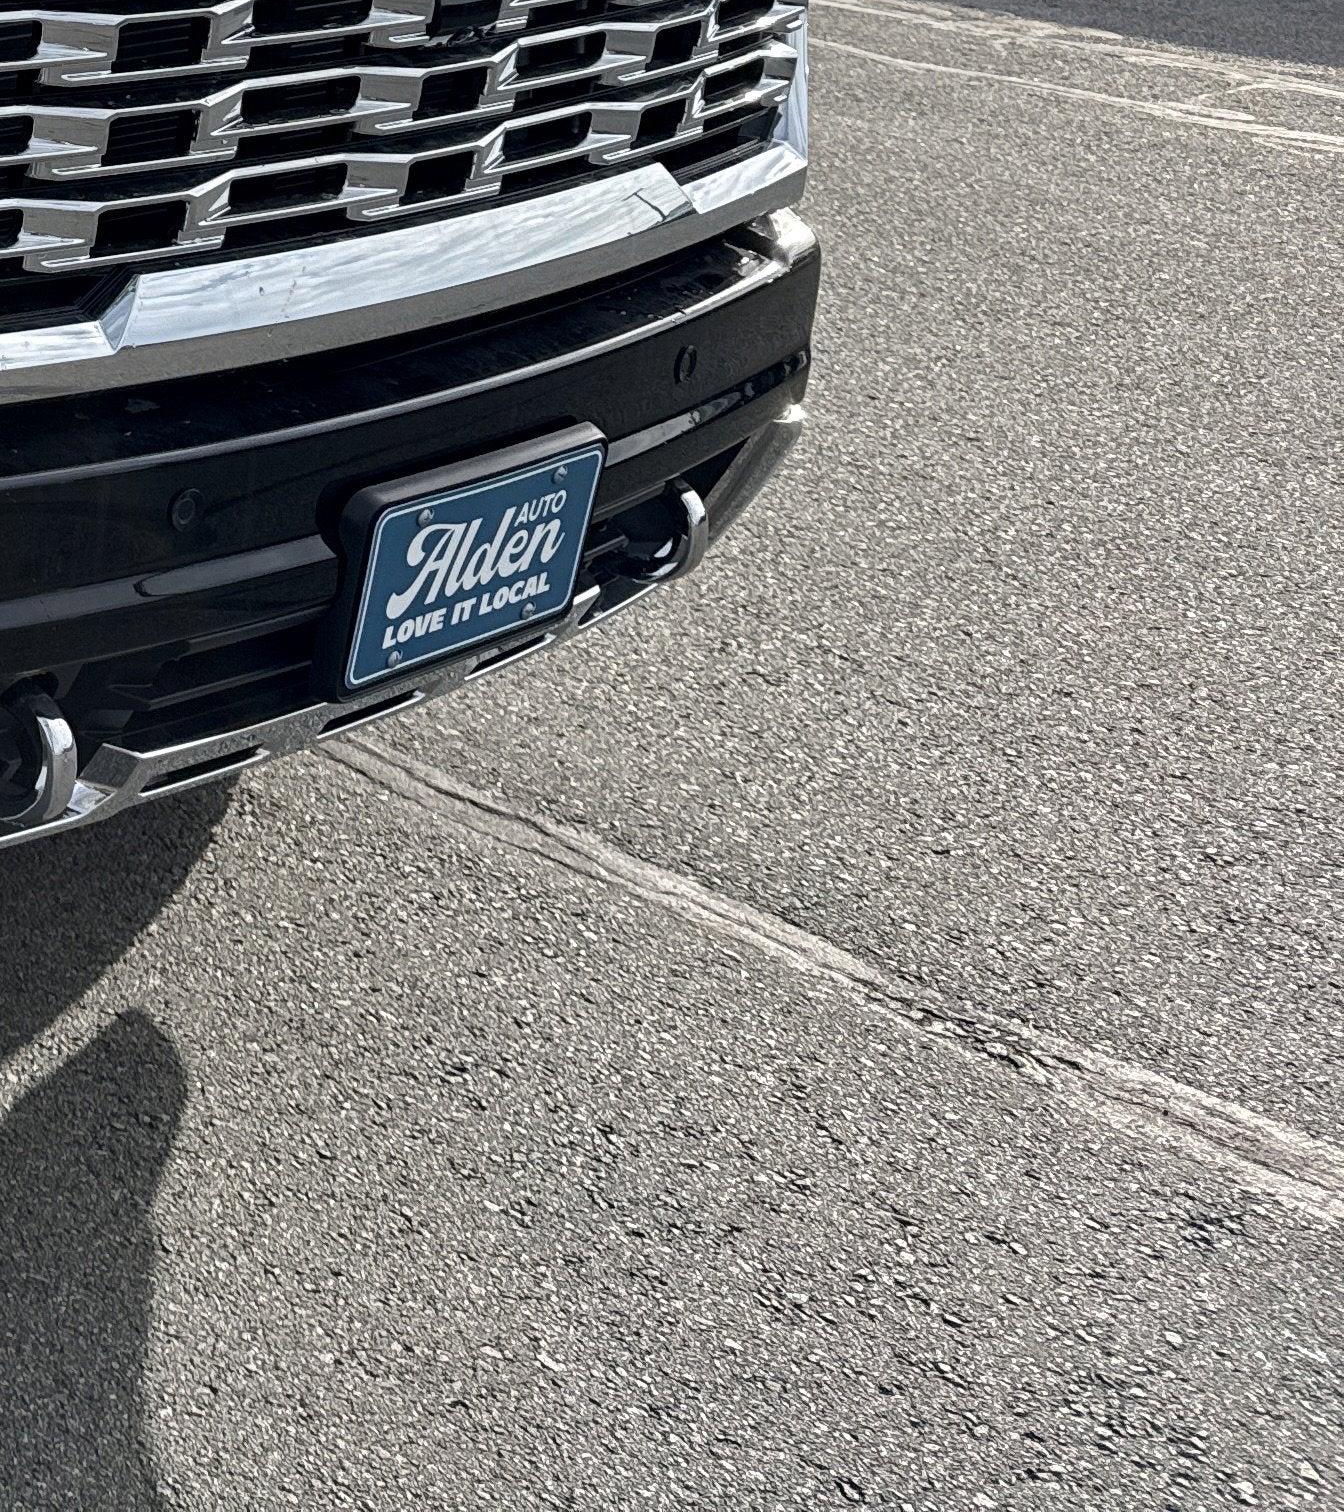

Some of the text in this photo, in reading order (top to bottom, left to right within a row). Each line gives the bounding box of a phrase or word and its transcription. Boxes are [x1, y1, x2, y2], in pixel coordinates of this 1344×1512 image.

[514, 489, 568, 529] AUTO
[385, 505, 566, 620] Alden
[381, 571, 552, 650] LOVE IT LOCAL
